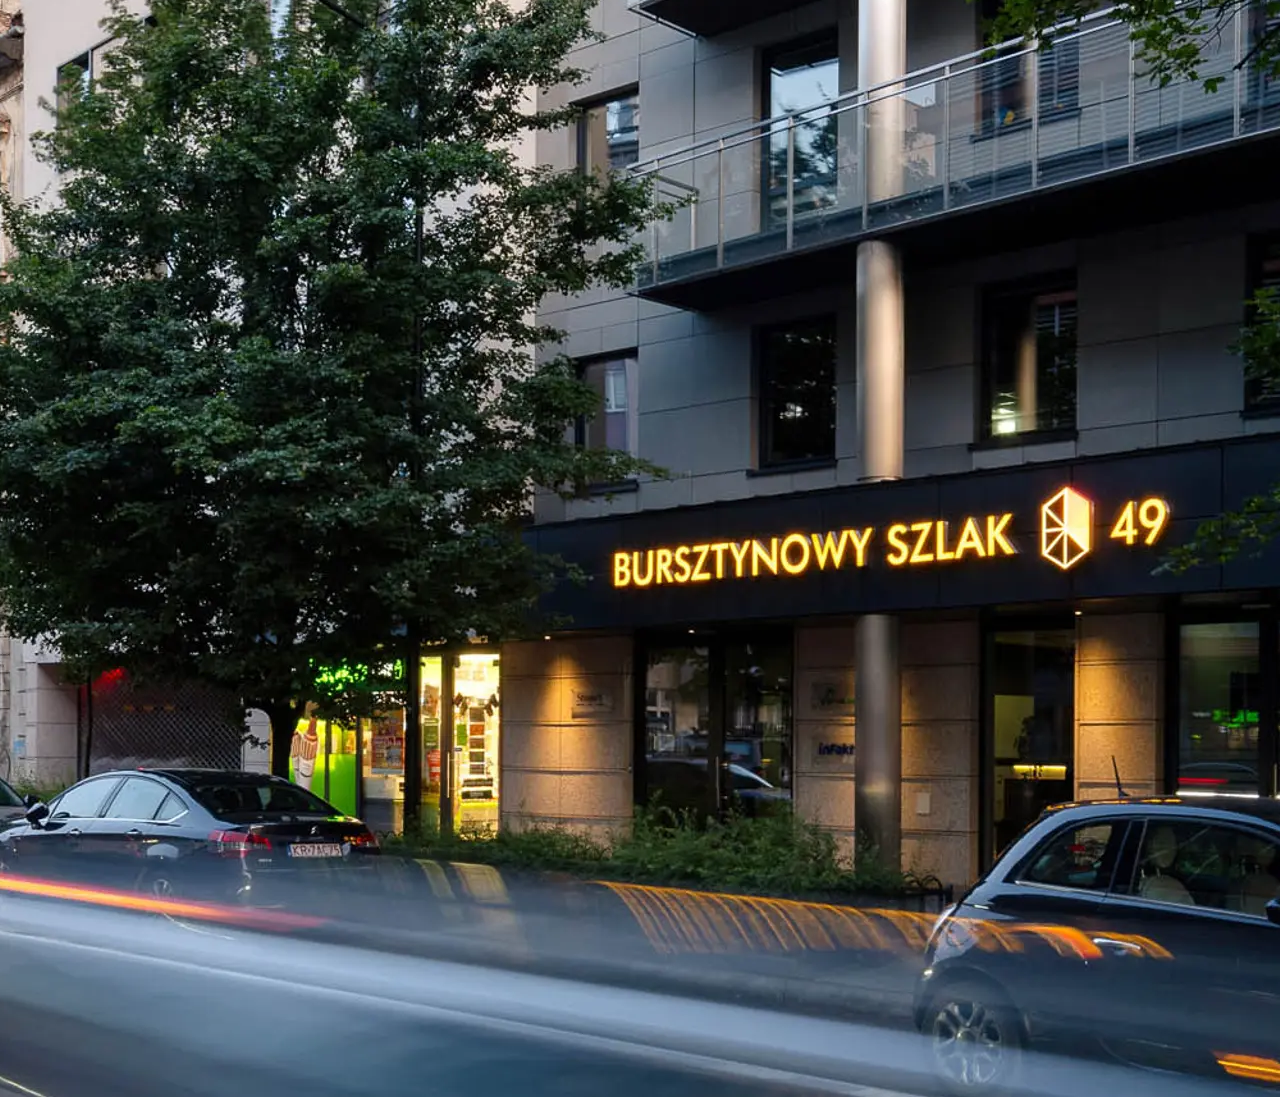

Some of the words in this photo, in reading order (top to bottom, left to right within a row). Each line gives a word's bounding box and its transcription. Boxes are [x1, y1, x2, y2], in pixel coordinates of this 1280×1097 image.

[613, 526, 873, 587] BURSZTYNOWY
[886, 513, 1018, 567] SZLAK
[1110, 497, 1170, 546] 49
